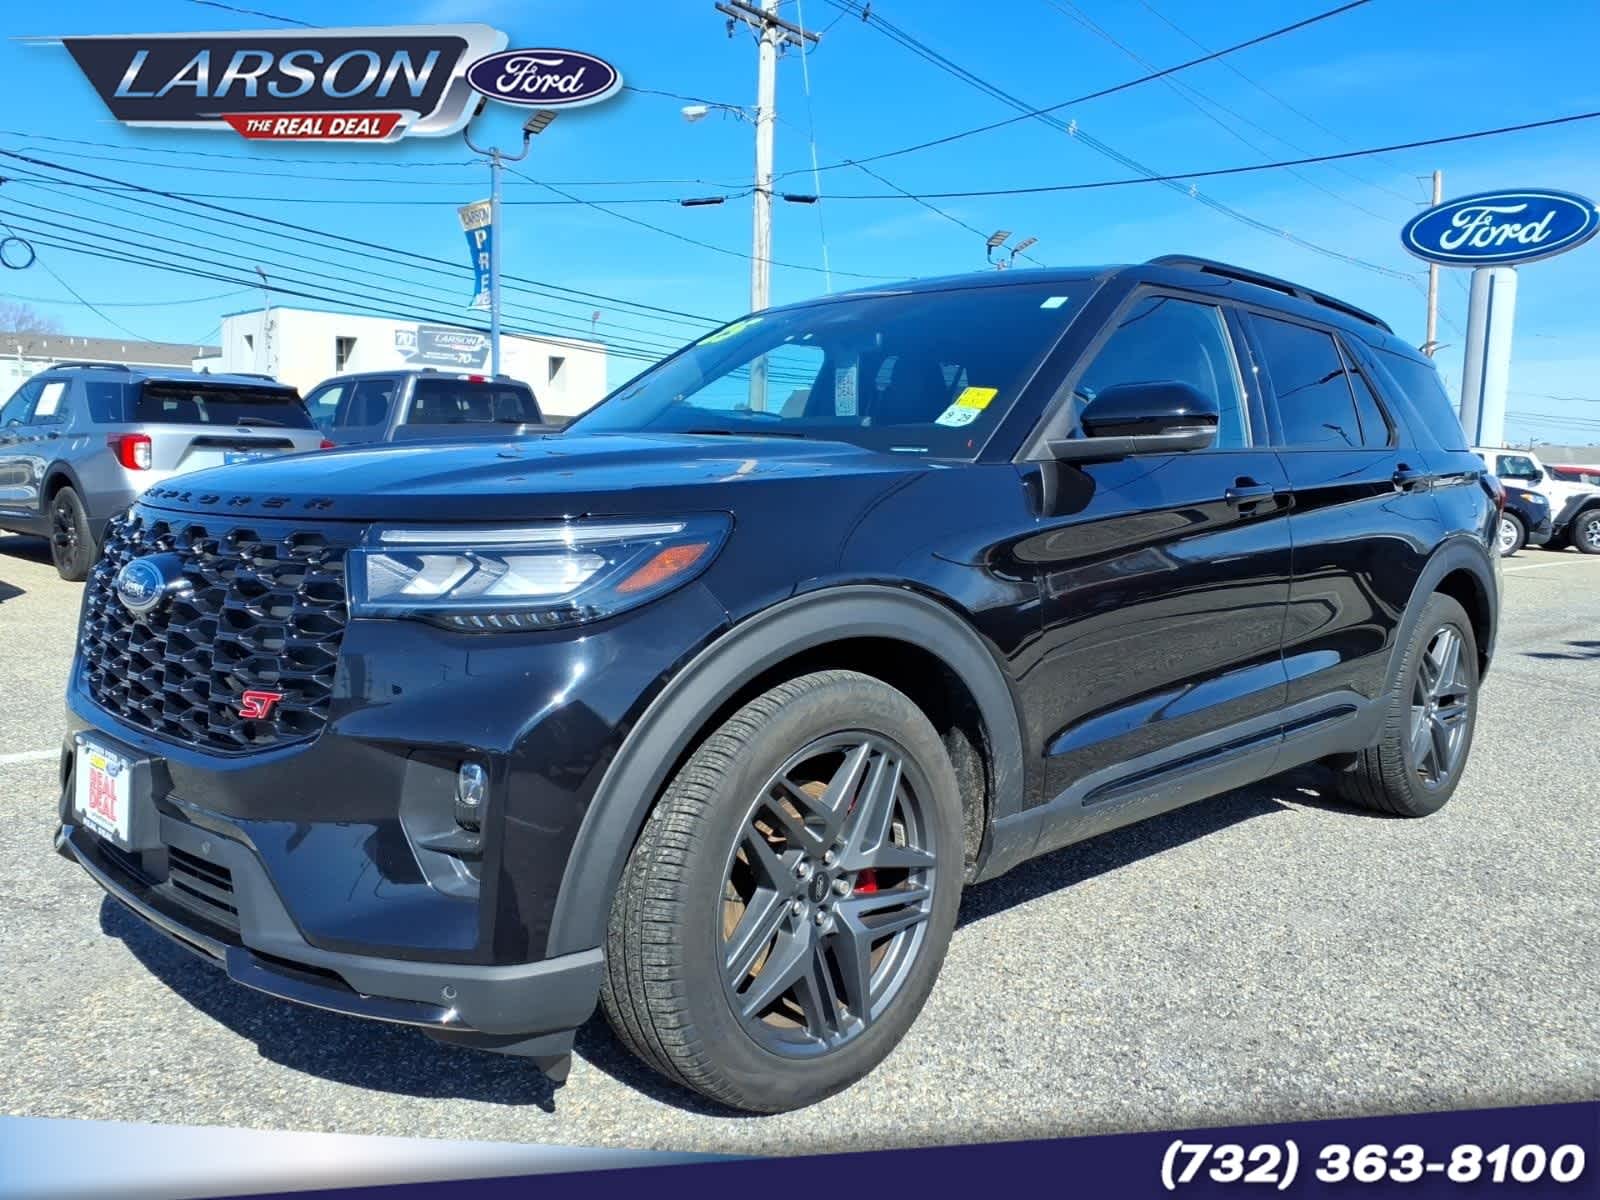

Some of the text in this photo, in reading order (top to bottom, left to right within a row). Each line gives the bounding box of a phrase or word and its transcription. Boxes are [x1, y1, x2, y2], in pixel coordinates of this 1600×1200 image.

[1439, 203, 1557, 250] Ford
[239, 690, 283, 719] ST
[89, 767, 117, 801] REAL
[89, 785, 117, 822] DEAL
